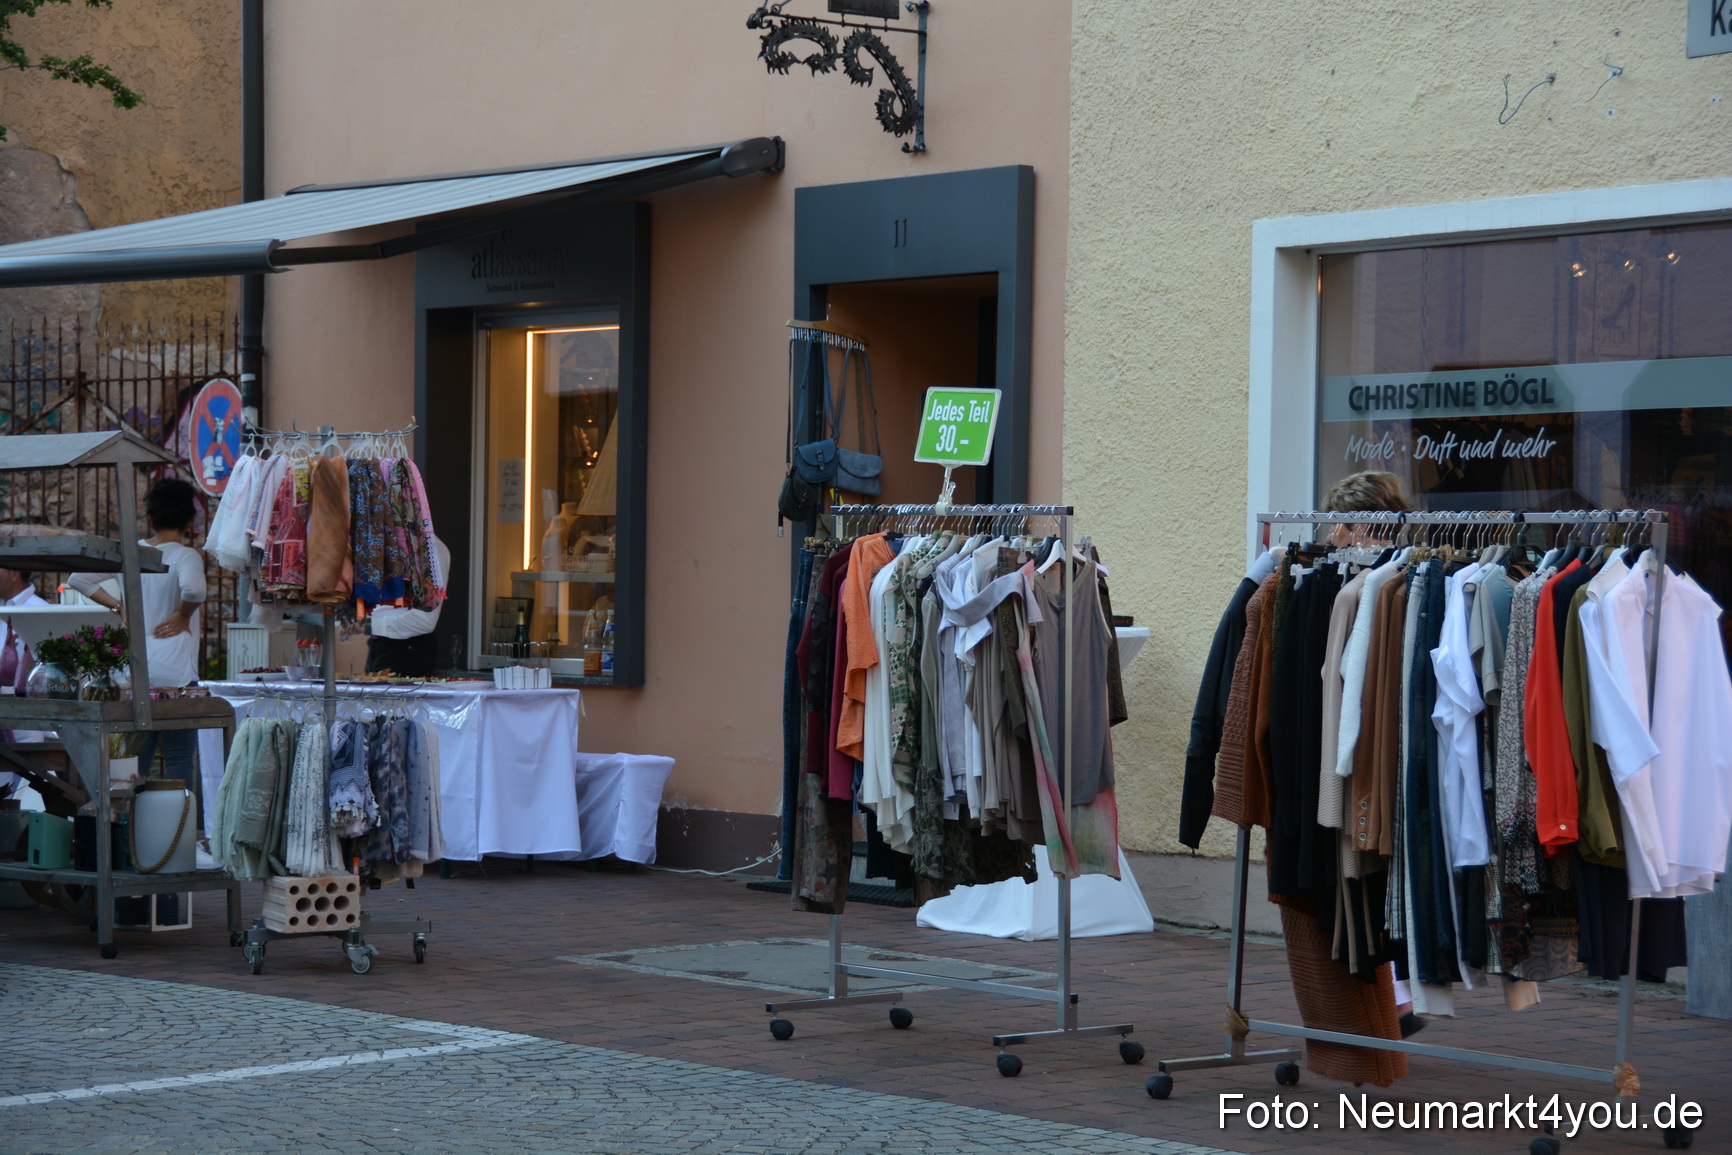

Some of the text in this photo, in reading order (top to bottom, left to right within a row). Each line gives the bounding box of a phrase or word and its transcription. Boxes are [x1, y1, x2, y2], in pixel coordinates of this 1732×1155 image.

[1710, 0, 1732, 37] K
[893, 218, 907, 248] 11
[471, 239, 569, 279] atlas saray
[486, 282, 512, 292] Schmuck
[1348, 373, 1554, 411] CHRISTINE BÖGL
[927, 399, 991, 423] Jedes Teil
[935, 424, 969, 454] 30,-
[1344, 431, 1395, 463] Mode
[1413, 430, 1458, 465] Duft
[1459, 428, 1502, 460] und
[1502, 426, 1556, 459] mehr
